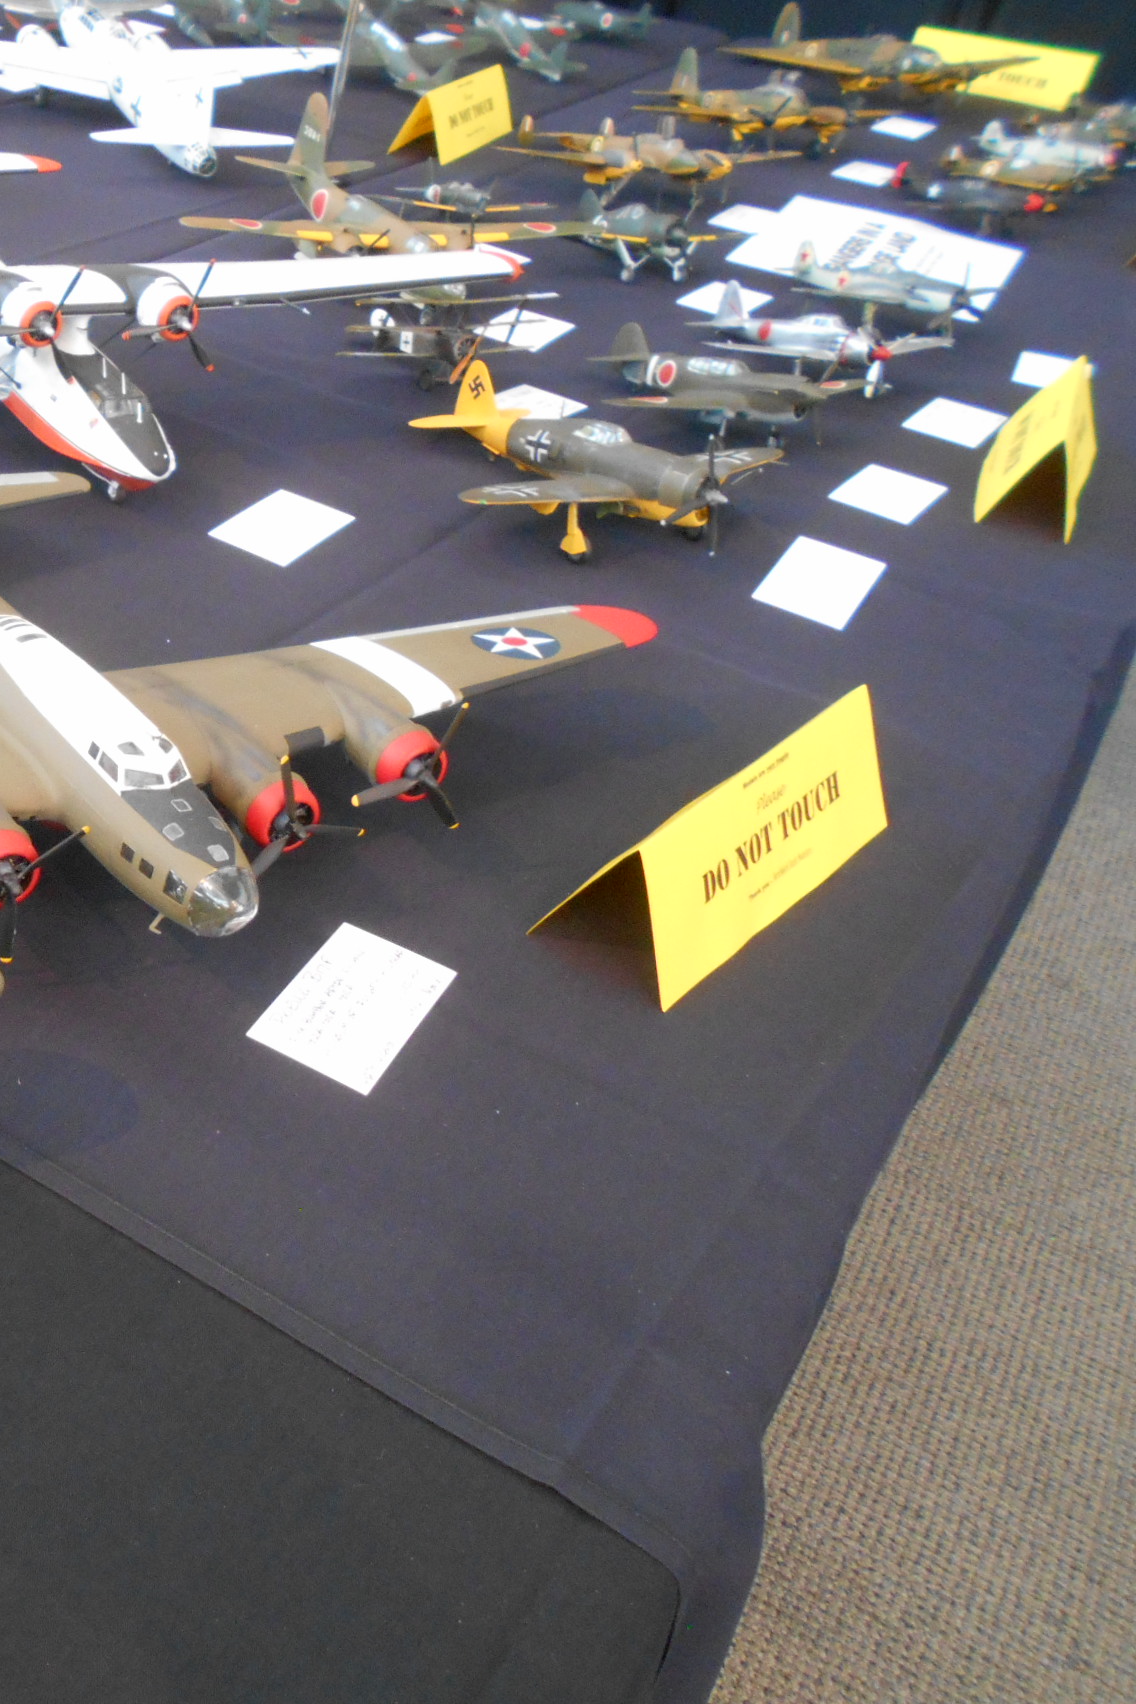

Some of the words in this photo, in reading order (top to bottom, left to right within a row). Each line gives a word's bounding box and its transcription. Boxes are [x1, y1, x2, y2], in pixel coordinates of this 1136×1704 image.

[702, 858, 731, 905] DO
[735, 820, 774, 878] NOT
[777, 770, 841, 841] TOUCH
